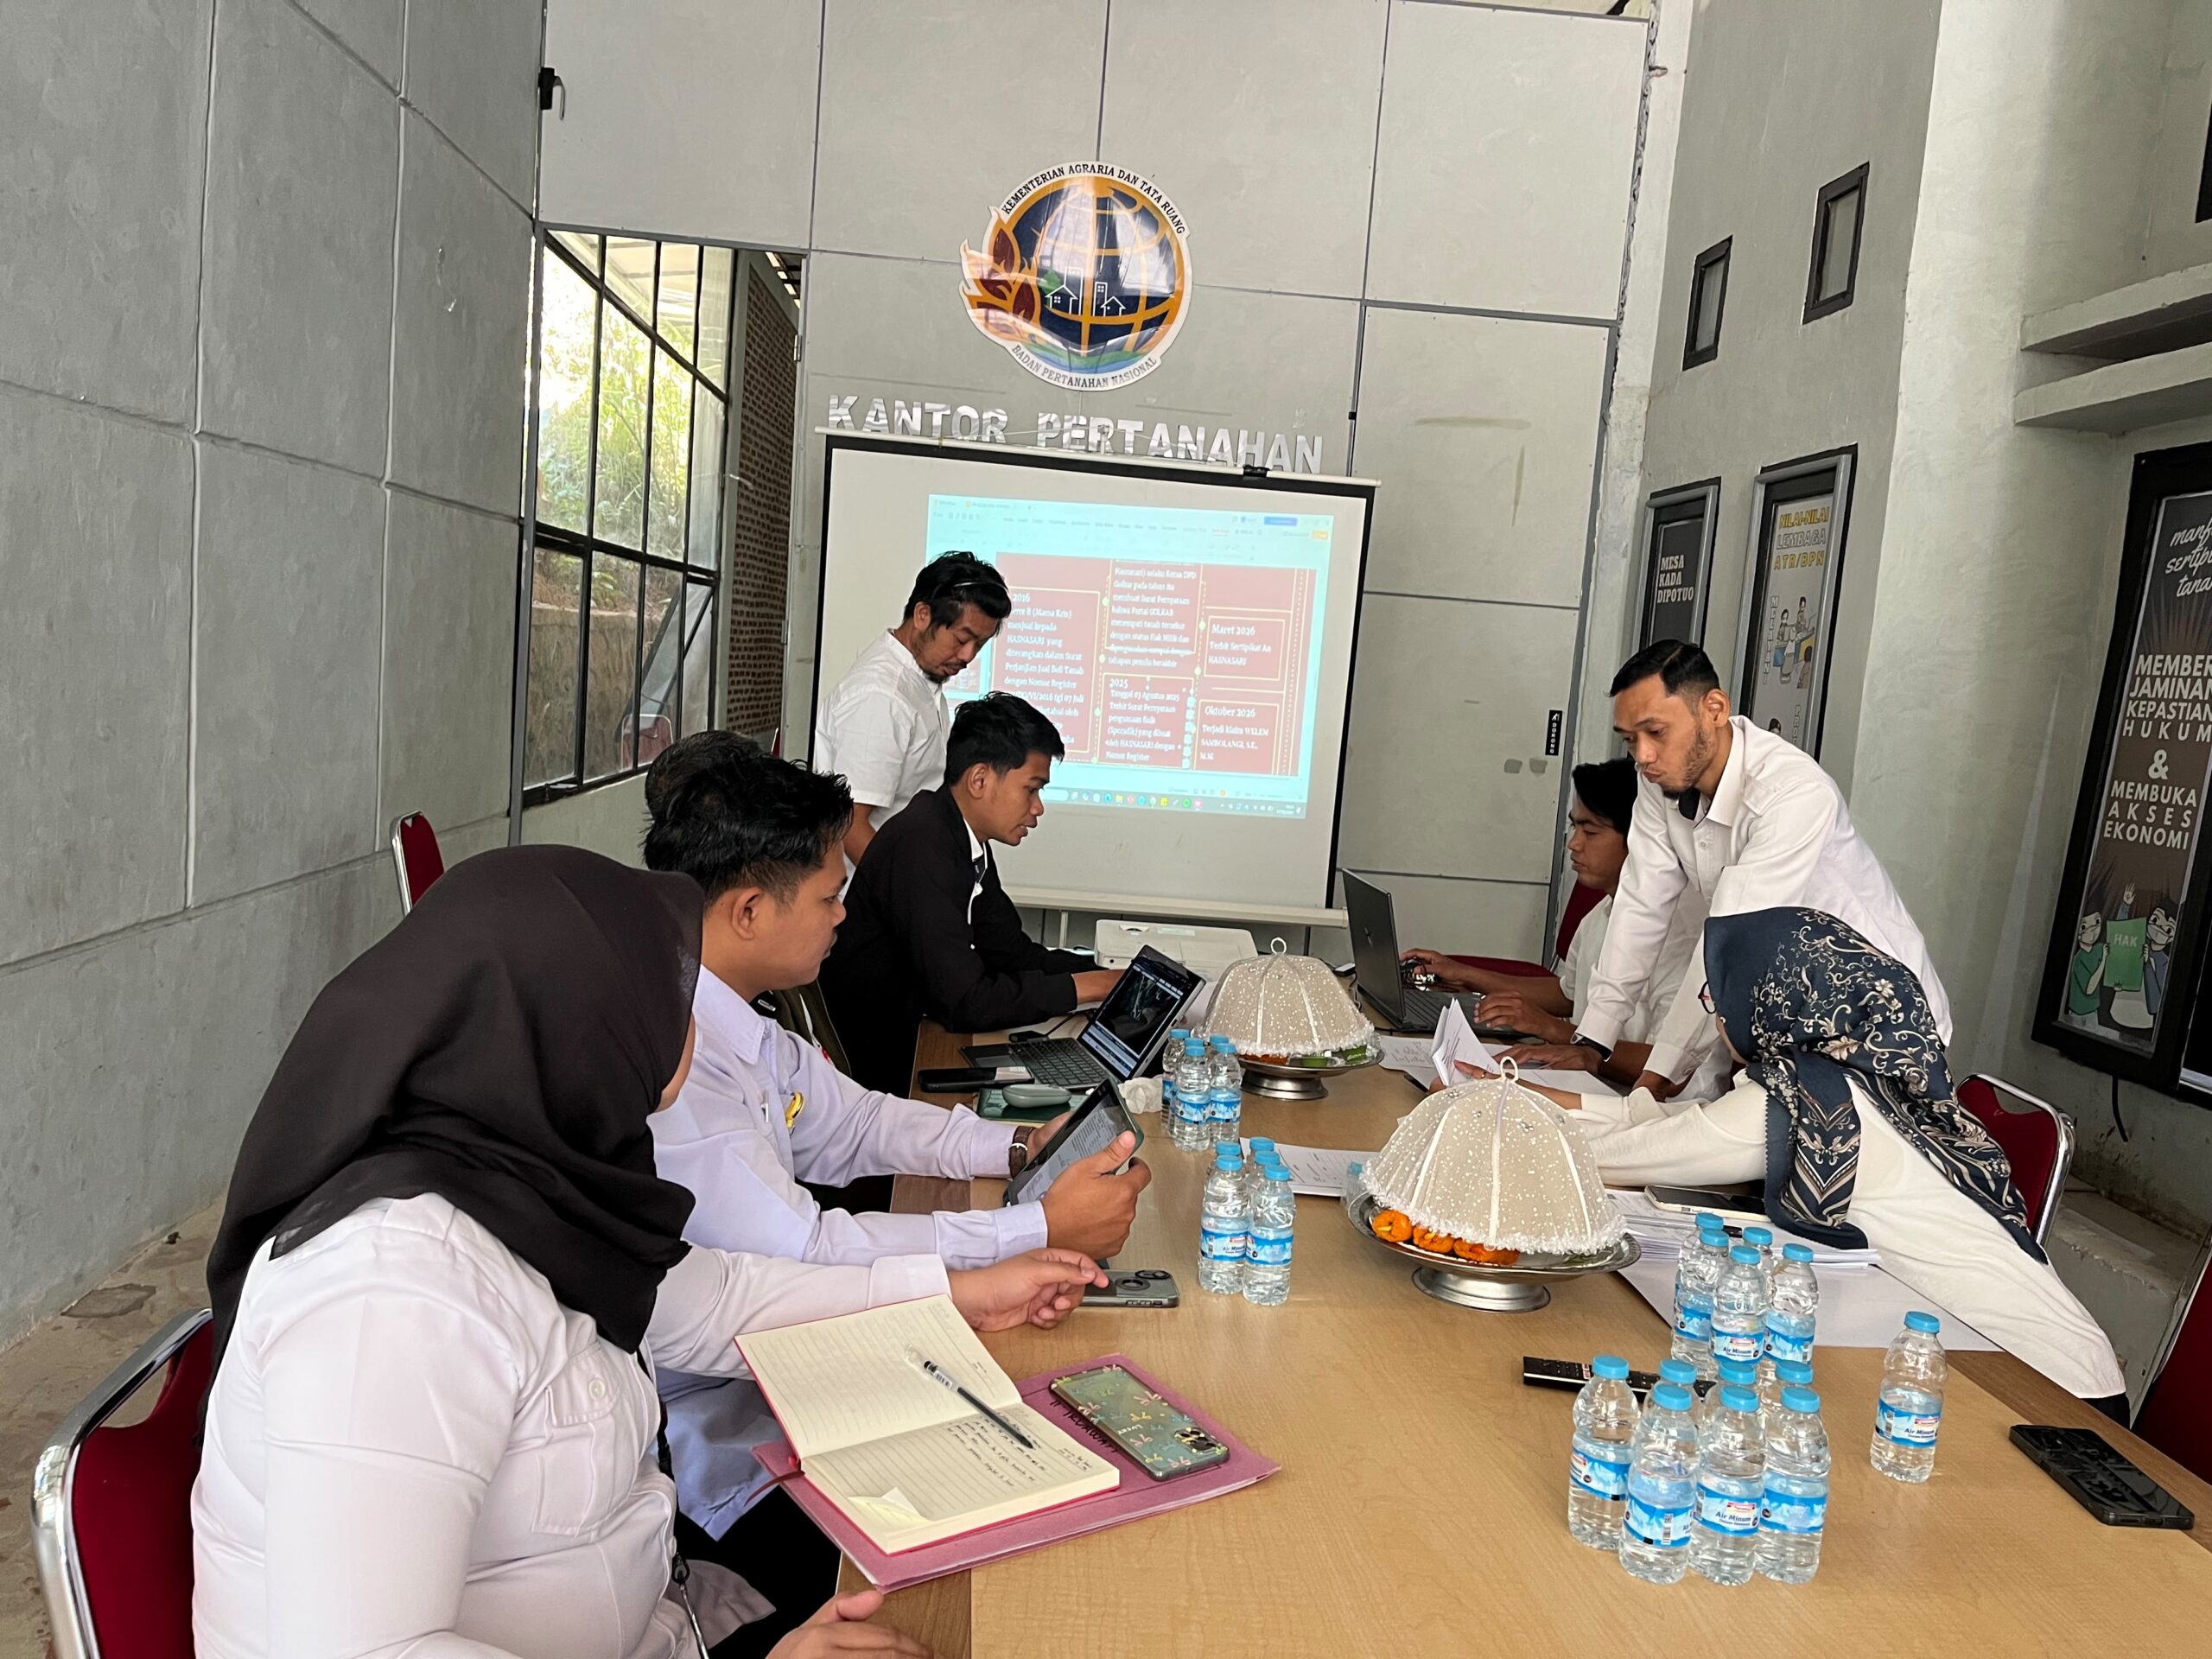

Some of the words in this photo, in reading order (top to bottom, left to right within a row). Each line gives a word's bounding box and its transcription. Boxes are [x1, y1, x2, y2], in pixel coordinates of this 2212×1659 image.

[1001, 166, 1065, 215] KEMENTERIAN
[1068, 163, 1115, 176] AGRARIA
[1118, 169, 1140, 186] DAN
[1141, 180, 1164, 204] TATA
[1161, 201, 1186, 235] RUANG
[1012, 344, 1042, 373] BADAN
[1041, 367, 1109, 389] PERTANAHAN
[1111, 356, 1158, 387] NASIONAL
[828, 394, 1008, 443] KANTOR
[1037, 412, 1323, 474] PERTANAHAN
[1779, 506, 1830, 530] NILAI-NILAI
[1777, 528, 1827, 550] LEMBAGA
[1661, 555, 1684, 571] MESA
[1774, 550, 1825, 570] ATR/BPN
[1659, 571, 1681, 587] KADA
[1013, 593, 1031, 602] 2016
[1657, 587, 1694, 603] DIPOTUO
[1211, 624, 1235, 635] Maret
[1109, 677, 1129, 690] 2025
[2126, 700, 2212, 721] KEPASTIAN
[1549, 722, 1560, 754] DORONG
[2122, 719, 2212, 743] HUKUM
[2148, 749, 2169, 780] &
[2110, 779, 2197, 807] MEMBUKA
[2108, 800, 2193, 828] AKSES
[2103, 821, 2190, 850] EKONOMI
[2113, 933, 2138, 948] HAK
